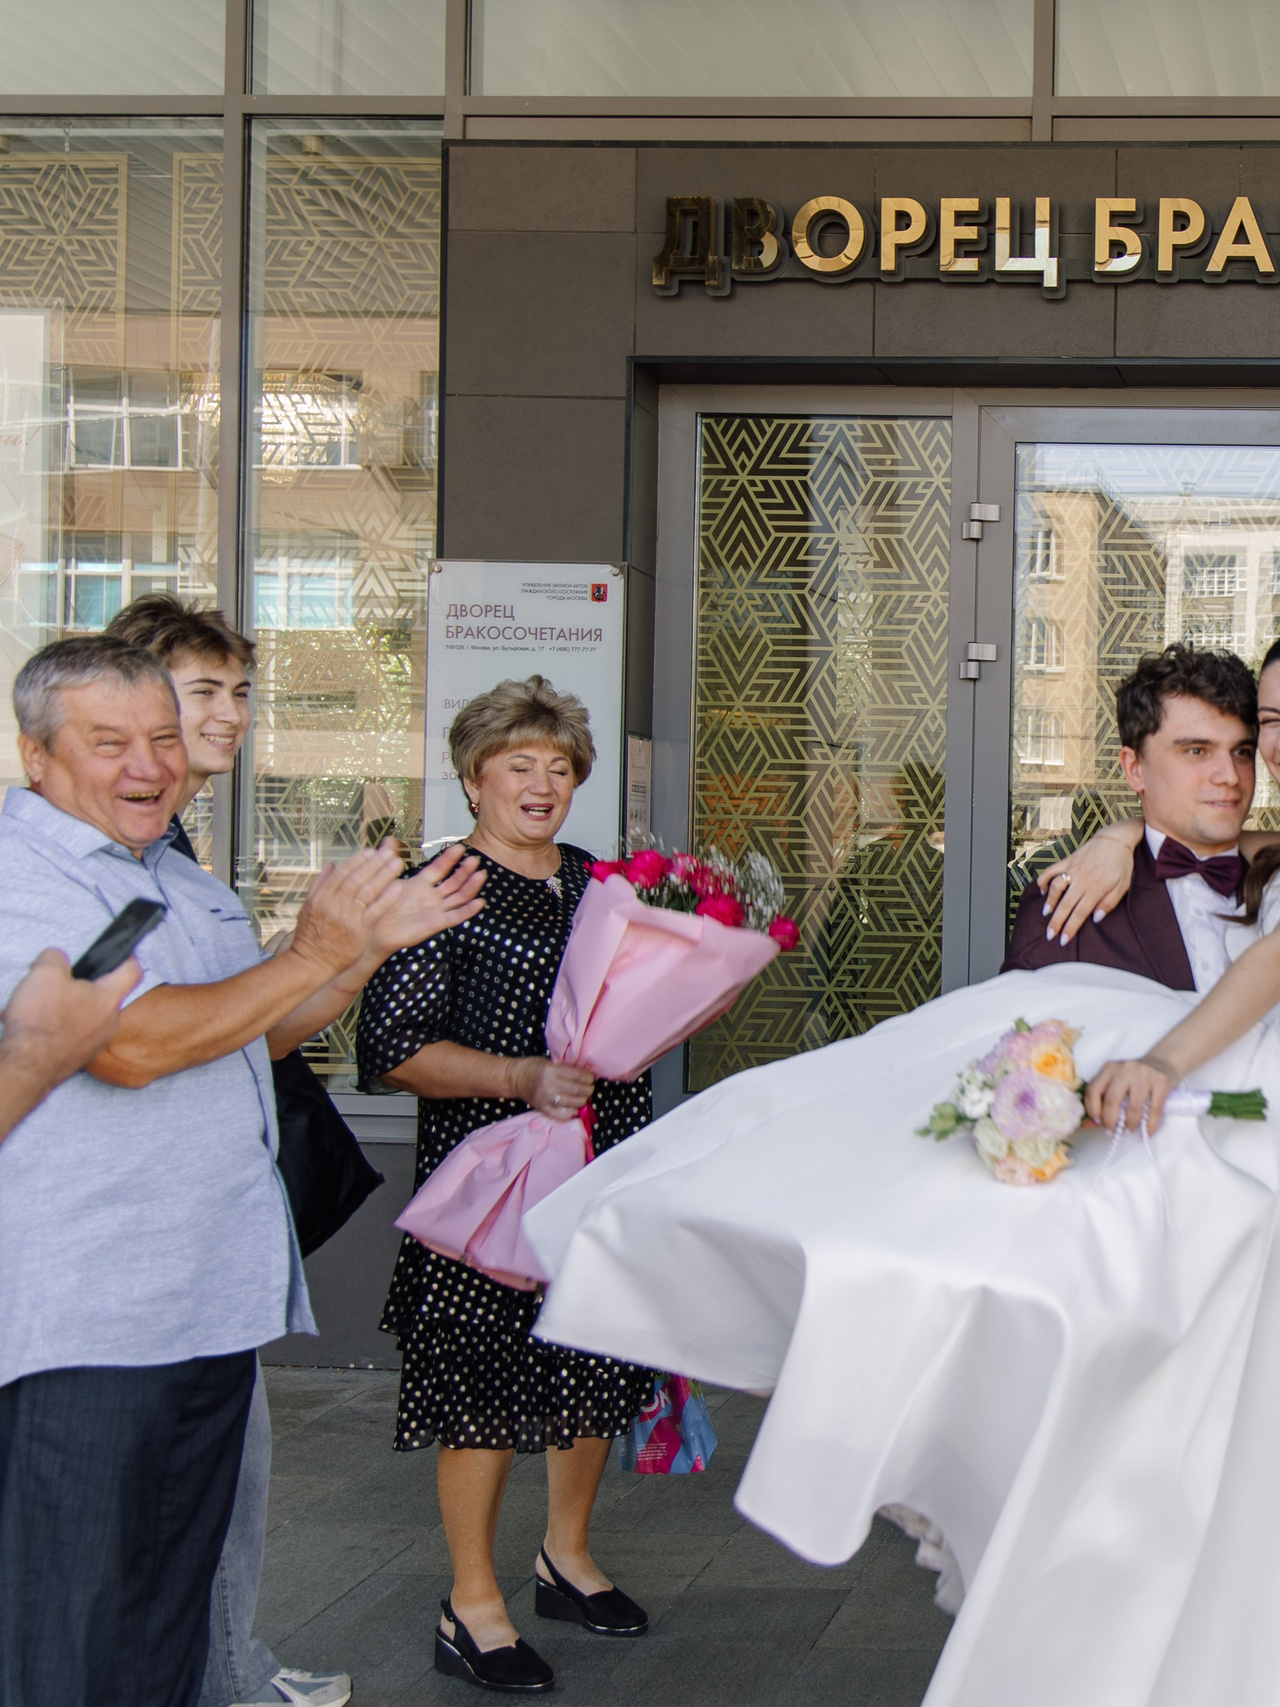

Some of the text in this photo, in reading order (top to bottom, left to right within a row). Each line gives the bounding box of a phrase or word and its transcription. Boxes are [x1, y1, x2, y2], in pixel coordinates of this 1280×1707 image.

[652, 196, 1058, 288] ДВОРЕЦ
[446, 604, 515, 621] ДВОРЕЦ
[445, 625, 603, 641] БРАКОСОЧЕТАНИЯ
